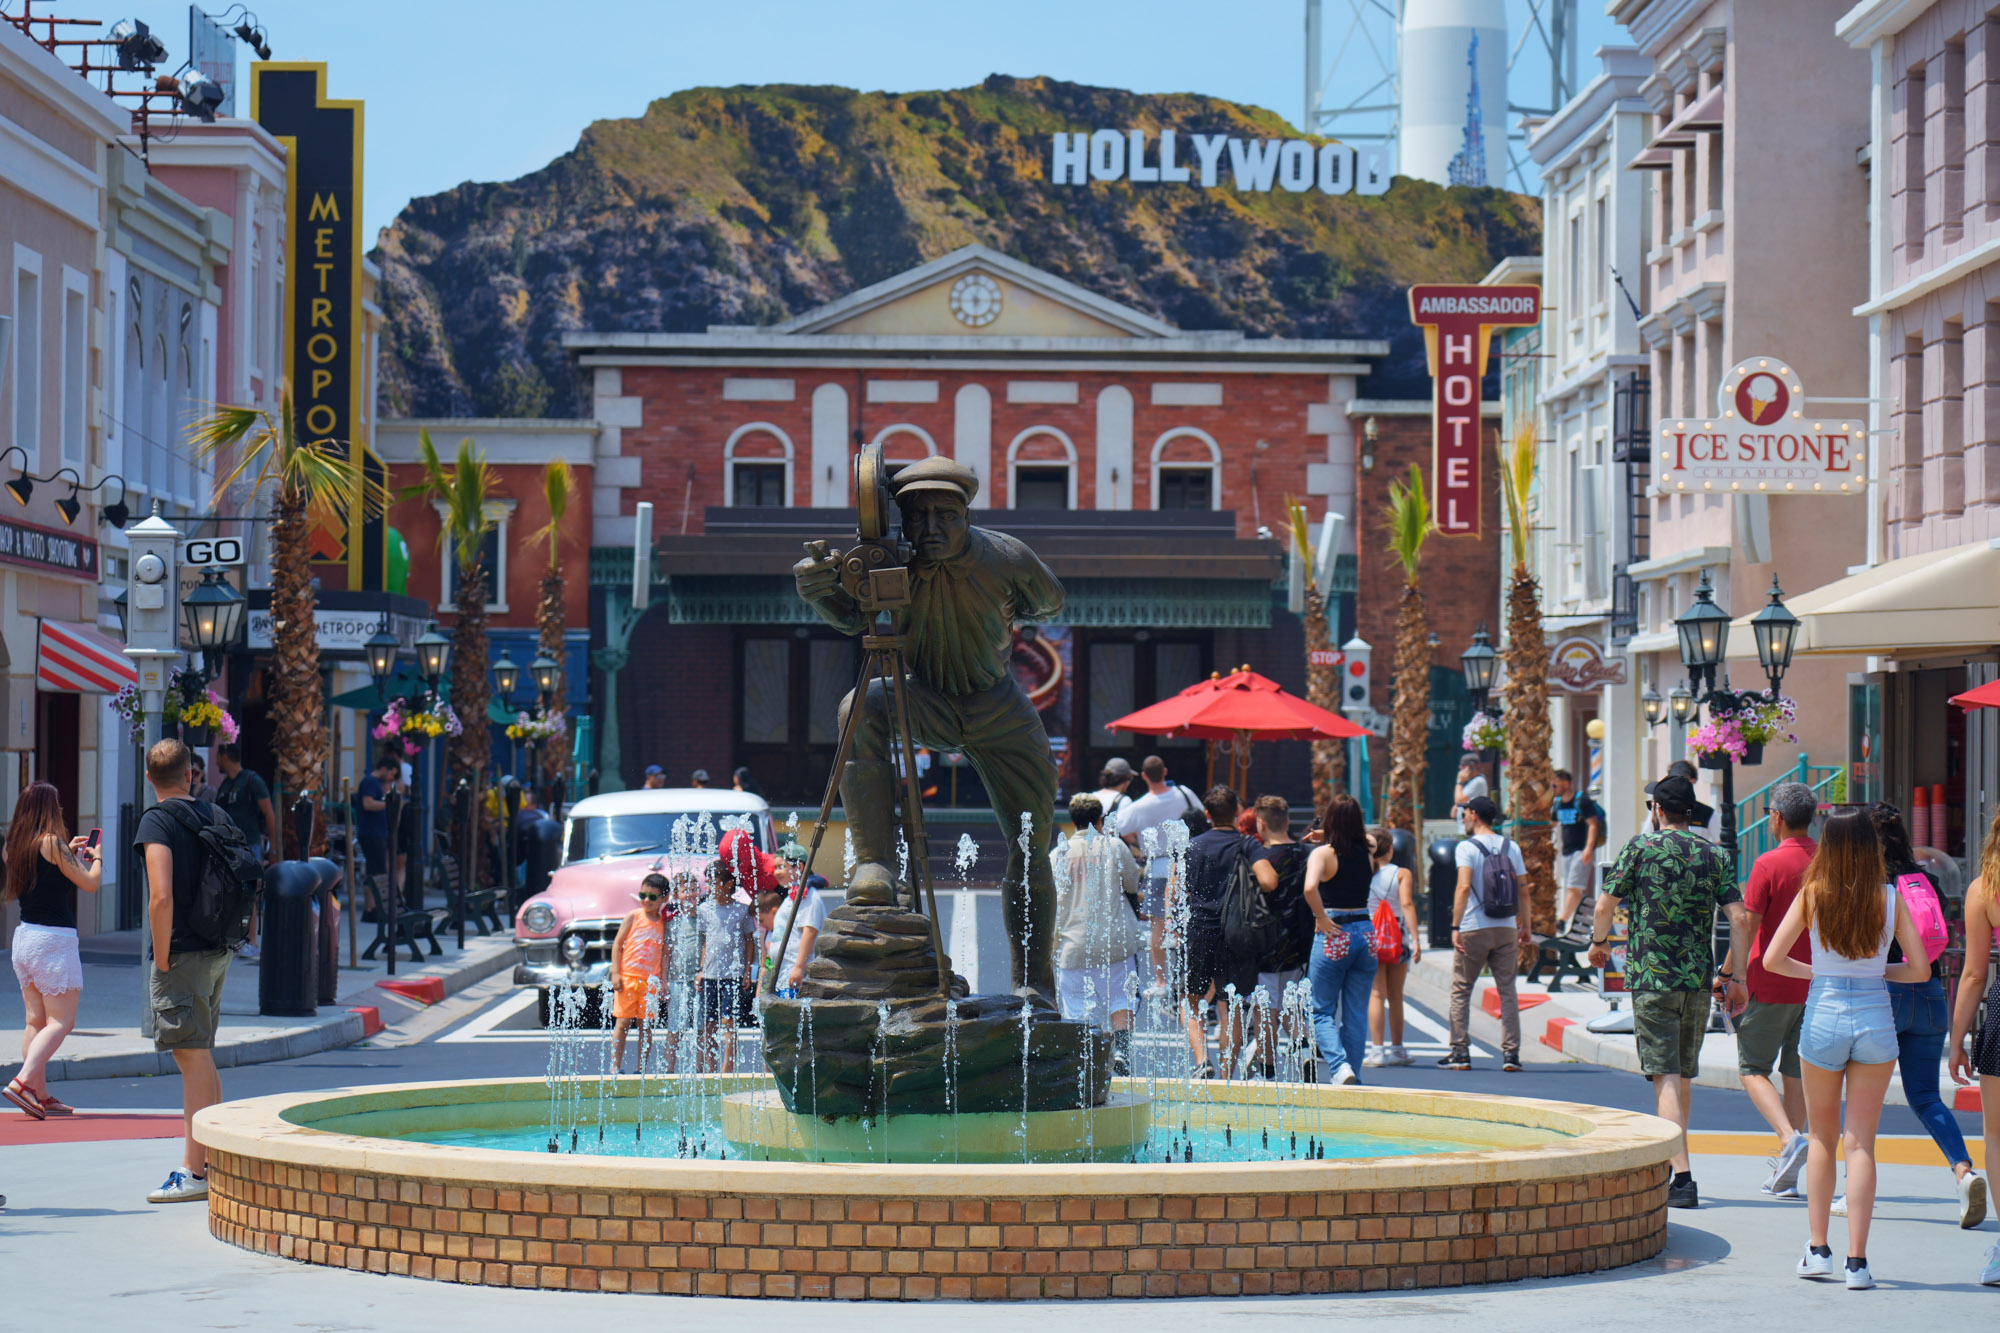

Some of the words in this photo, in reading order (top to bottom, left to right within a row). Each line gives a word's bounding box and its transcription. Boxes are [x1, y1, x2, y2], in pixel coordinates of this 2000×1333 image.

[1052, 129, 1391, 196] HOLLYWOOD
[307, 192, 340, 436] METROPO
[1420, 297, 1534, 314] AMBASSADOR
[1444, 334, 1472, 530] HOTEL
[1673, 433, 1728, 470] ICE
[1738, 433, 1850, 472] STONE
[1702, 468, 1808, 477] CREAMERY
[23, 530, 45, 560] PHOTO
[47, 536, 77, 568] SHOOTING
[186, 540, 241, 564] GO
[1312, 651, 1340, 664] STOP
